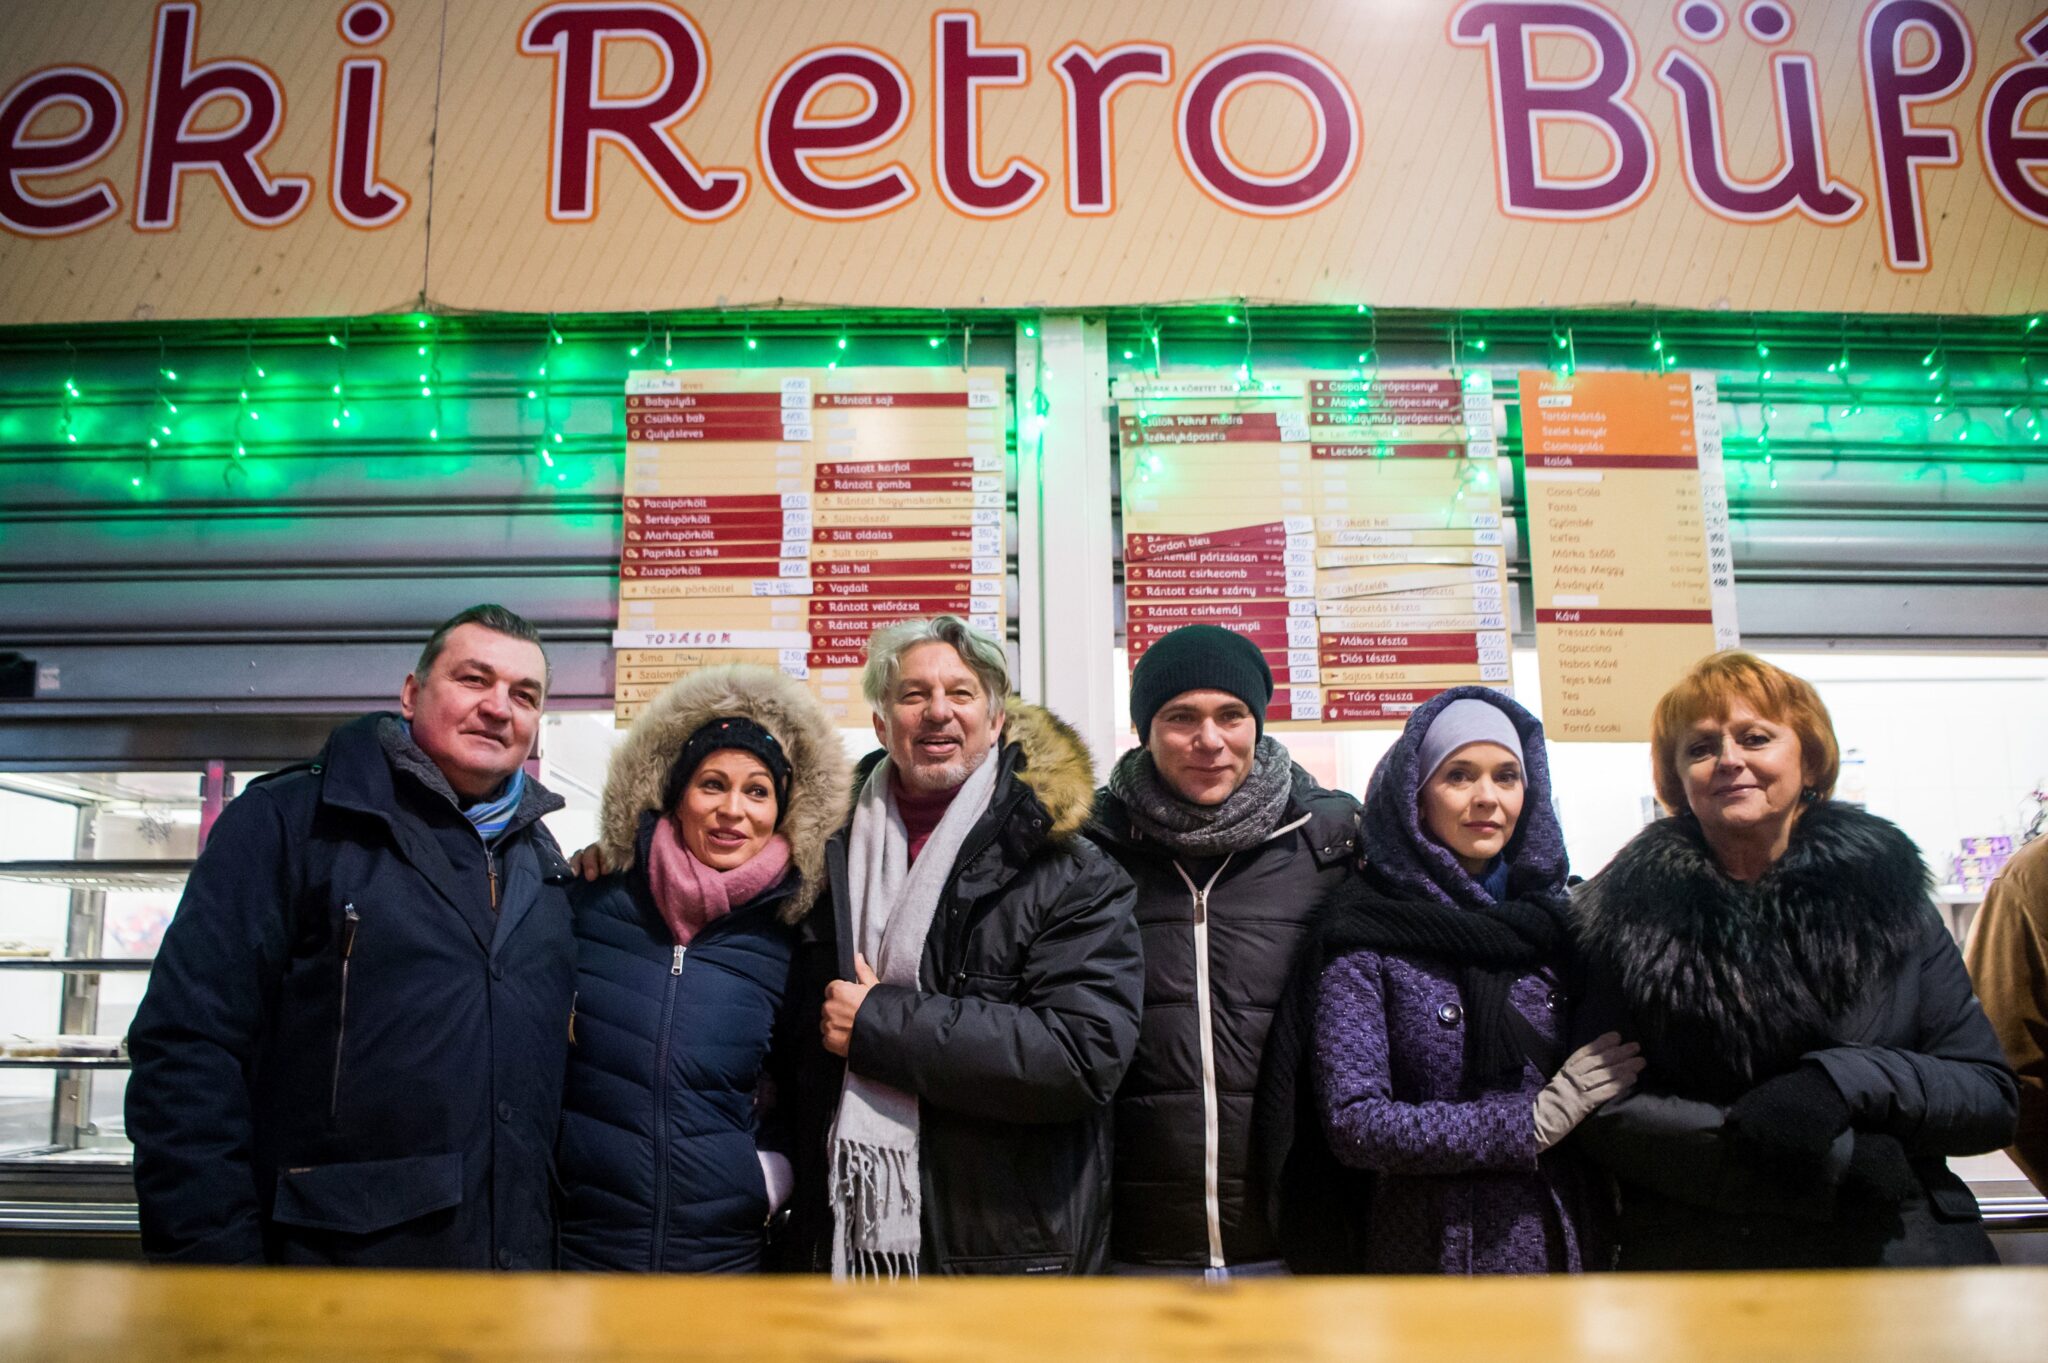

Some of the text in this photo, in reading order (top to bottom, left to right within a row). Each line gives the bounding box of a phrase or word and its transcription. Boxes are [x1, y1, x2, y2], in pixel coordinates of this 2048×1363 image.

[520, 0, 1364, 222] Retro
[1371, 382, 1439, 395] aprópecsenye
[644, 394, 697, 408] Babgulyás
[833, 394, 894, 408] Rántott sajt
[1382, 397, 1449, 410] aprópecsenye
[643, 412, 705, 424] Csülkös bab
[1394, 413, 1462, 426] aprópecsenye
[1543, 456, 1573, 467] Italok
[835, 464, 875, 476] Rántott
[877, 462, 911, 475] karfiol
[834, 480, 874, 491] Rántott
[876, 480, 912, 492] gomba
[643, 498, 708, 511] Pacalpörkölt
[644, 514, 711, 527] Sertéspörkölt
[643, 530, 715, 542] Marhapörkölt
[832, 530, 853, 541] Sült
[855, 529, 894, 541] oldalas
[1147, 541, 1187, 554] Cordon
[1188, 537, 1211, 548] bleu
[642, 547, 719, 561] Paprikás csirke
[1199, 553, 1259, 566] párizsiasan
[639, 565, 702, 578] Zuzapörkölt
[830, 563, 851, 575] Sült
[853, 563, 870, 574] hal
[1146, 568, 1187, 579] Rántott
[1189, 567, 1248, 579] csirkecomb
[829, 582, 869, 594] Vagdalt
[1146, 586, 1186, 597] Rántott
[1188, 586, 1220, 597] csirke
[1222, 585, 1257, 598] szárny
[828, 602, 869, 612] Rántott
[871, 600, 920, 612] velőrózsa
[1147, 605, 1243, 618] Rántott csirkemáj
[1555, 610, 1581, 622] Kávé
[828, 620, 869, 630] Rántott
[1339, 635, 1409, 647] Mákos tészta
[639, 652, 664, 664] Sima
[826, 654, 859, 664] Hurka
[1340, 652, 1397, 664] Diós tészta
[1347, 690, 1414, 702] Túrós csusza
[1561, 691, 1580, 701] Tea
[1342, 706, 1381, 718] Palacsinta
[1561, 706, 1597, 717] Kakaó
